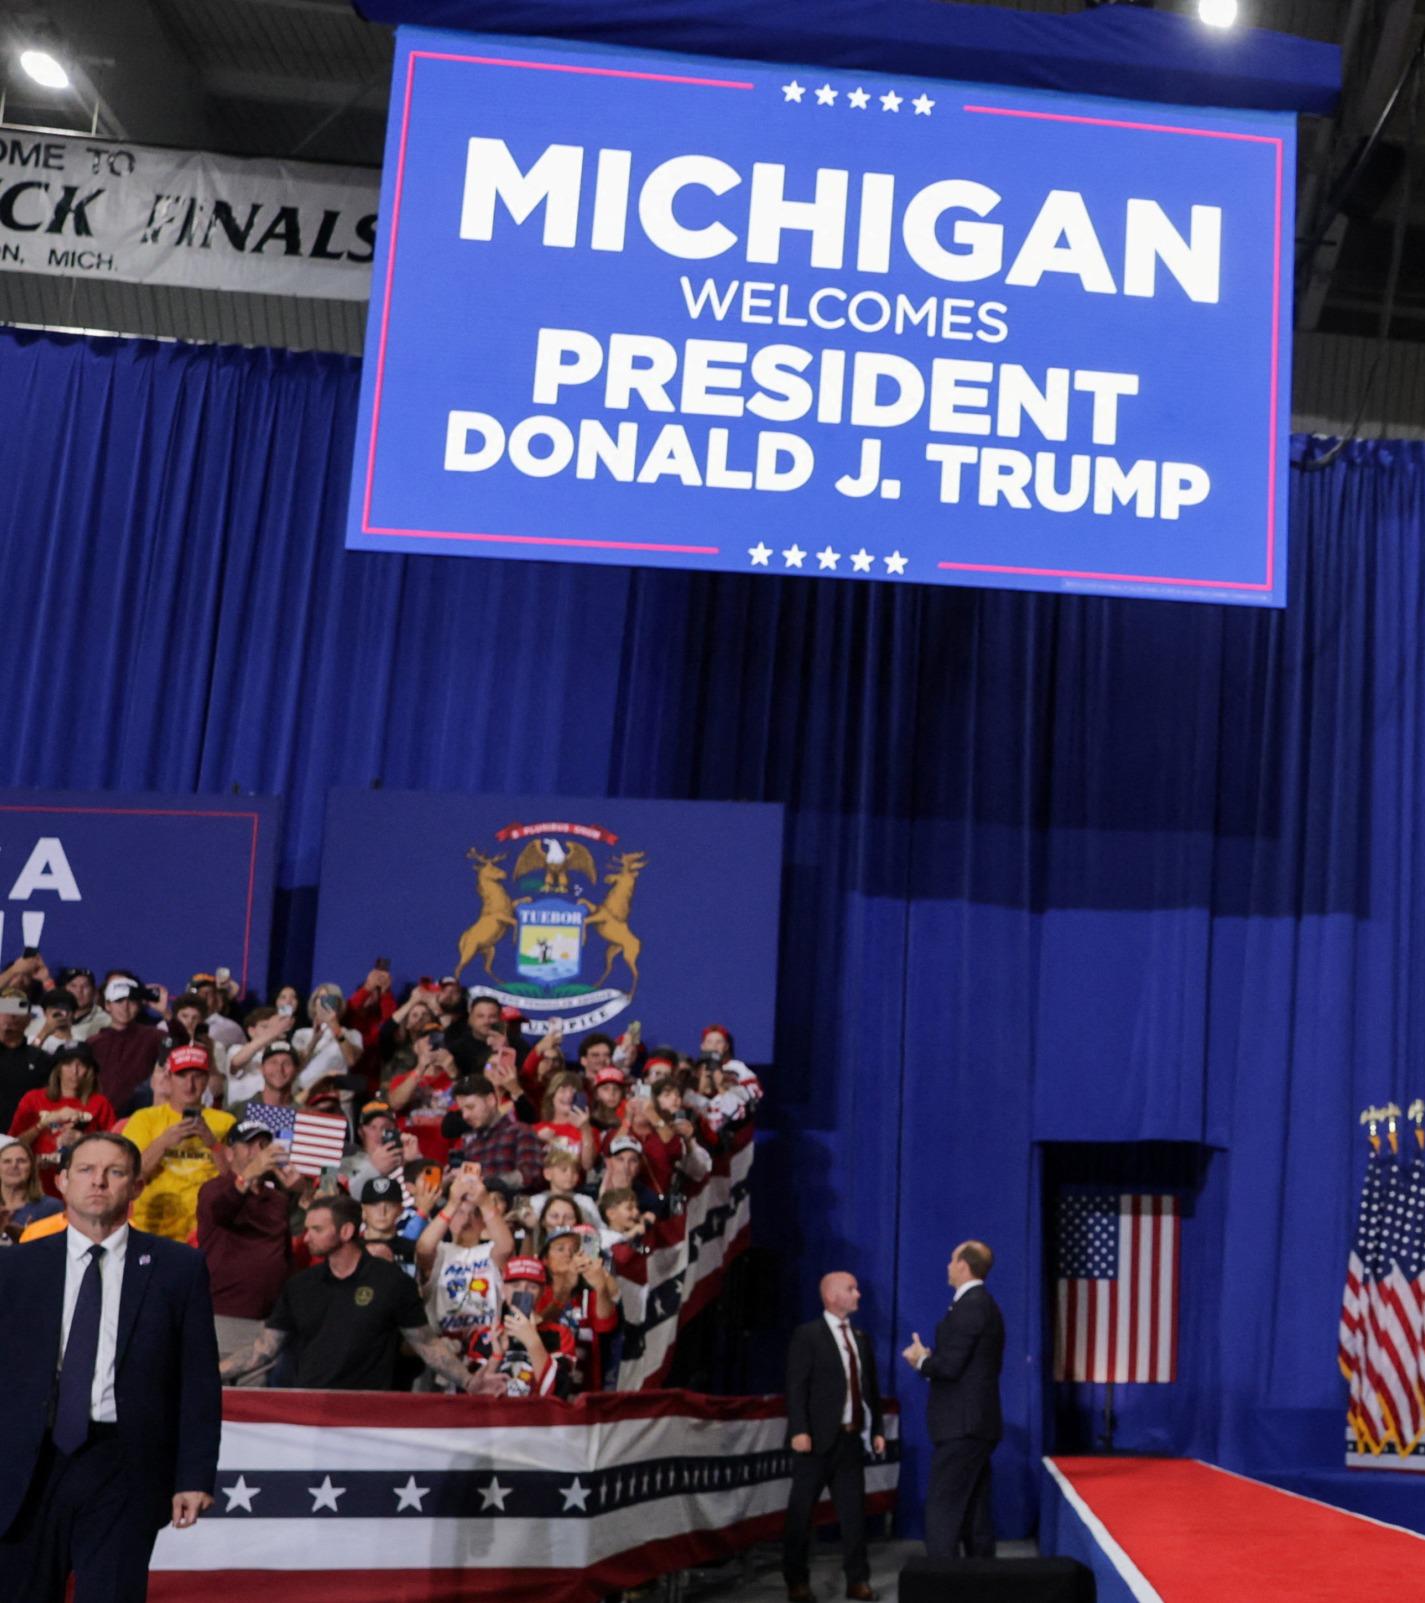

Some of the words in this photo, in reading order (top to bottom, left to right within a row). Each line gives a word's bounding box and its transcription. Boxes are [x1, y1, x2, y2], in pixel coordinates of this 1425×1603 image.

[86, 147, 136, 176] TO
[0, 178, 105, 237] CK
[460, 138, 1221, 303] MICHIGAN
[0, 243, 24, 265] N,
[48, 248, 118, 272] MICH.
[681, 277, 1007, 342] WELCOMES
[534, 329, 1138, 444] PRESIDENT
[445, 411, 813, 490] DONALD
[836, 439, 900, 498] J.
[927, 444, 1210, 519] TRUMP
[521, 910, 582, 925] TUEBOR
